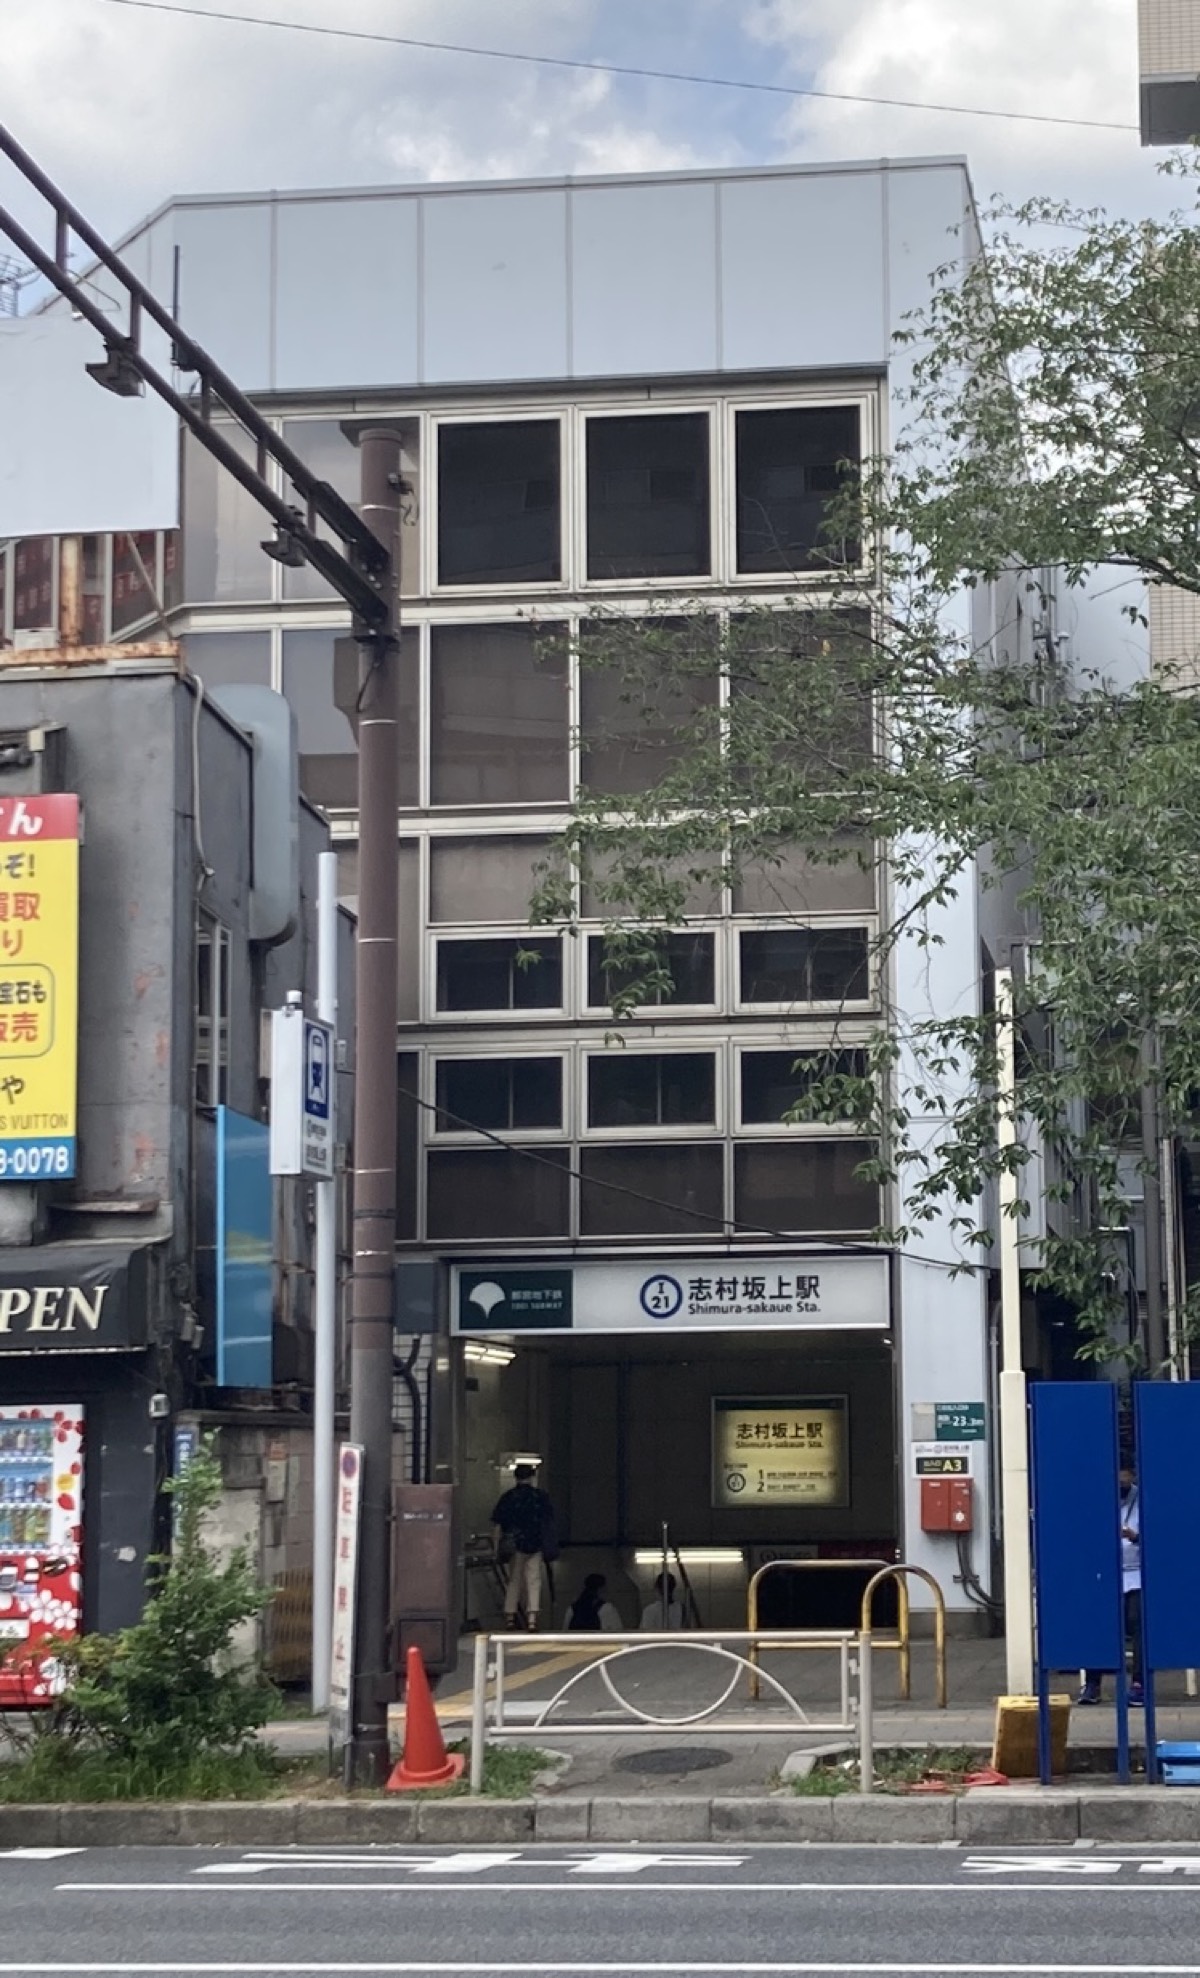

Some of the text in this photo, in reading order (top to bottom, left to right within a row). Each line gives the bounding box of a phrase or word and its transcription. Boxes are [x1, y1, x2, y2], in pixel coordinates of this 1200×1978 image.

[0, 802, 43, 835] ん
[0, 852, 35, 878] ぞ!
[11, 1113, 68, 1130] VUITTON
[688, 1275, 820, 1301] 志村坂上駅
[0, 1285, 109, 1332] PEN
[651, 1296, 670, 1309] 21
[688, 1301, 822, 1315] Shimura-sakaue Sta.
[736, 1422, 823, 1440] 志村坂上駅
[942, 1459, 962, 1472] A3
